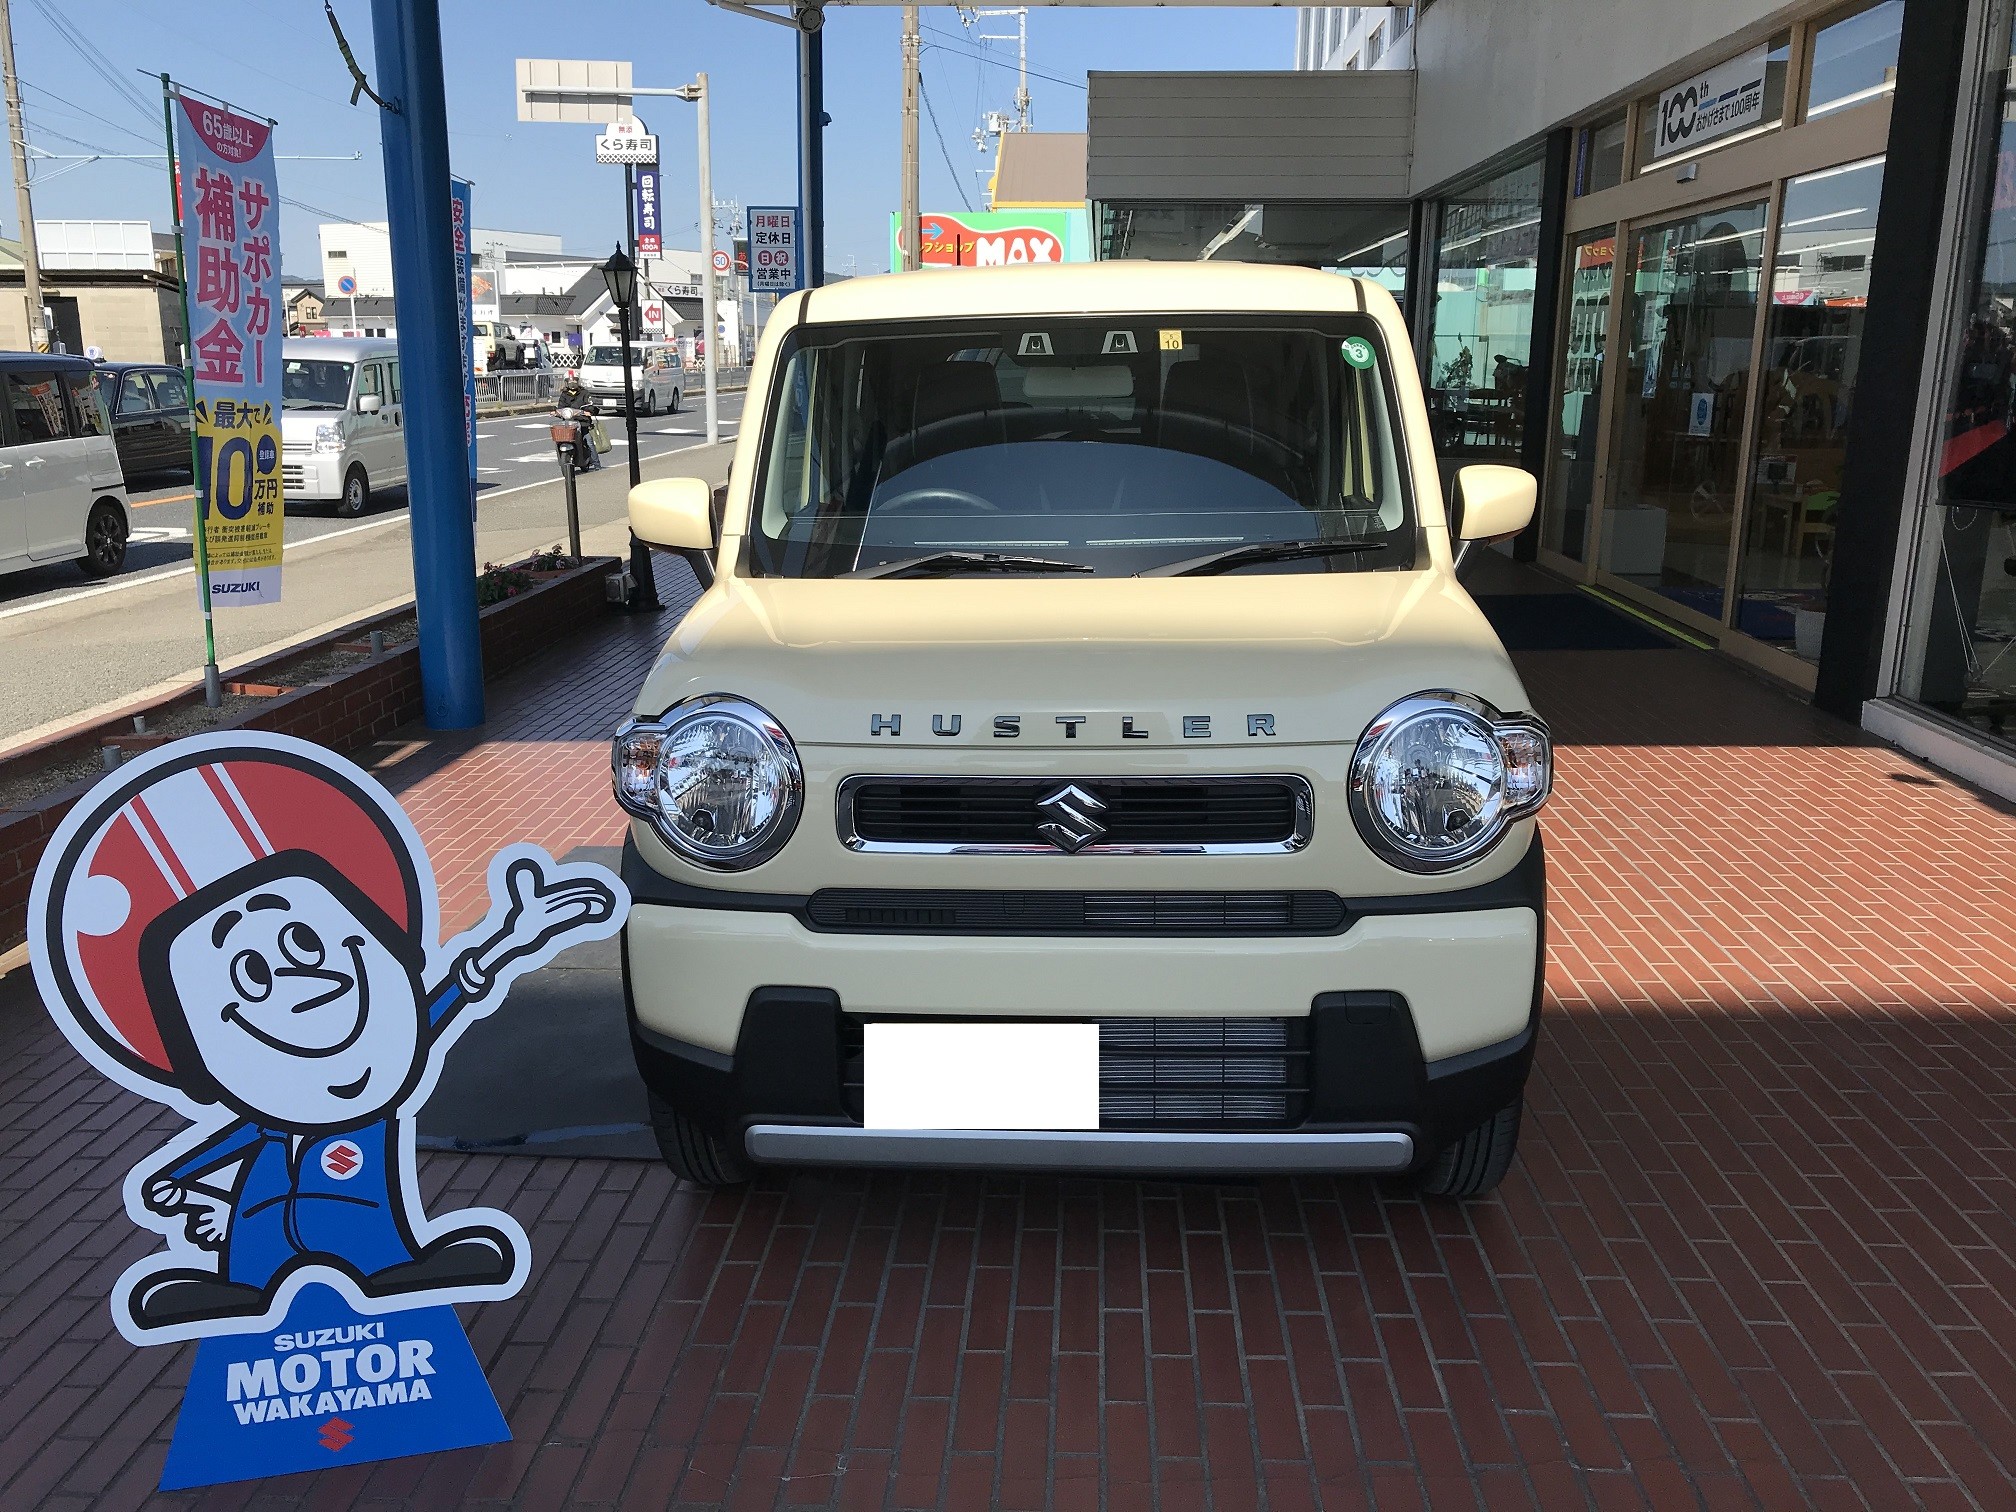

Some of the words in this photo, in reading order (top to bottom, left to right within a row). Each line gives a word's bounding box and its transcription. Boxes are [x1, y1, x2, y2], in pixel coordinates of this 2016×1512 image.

[1696, 90, 1761, 132] おかげさまで100周年
[203, 110, 253, 147] 65歳以上
[600, 139, 652, 151] くら寿司
[641, 175, 655, 230] 回転寿司
[755, 215, 790, 228] 月曜日
[755, 232, 791, 245] 定休日
[715, 257, 725, 265] 50
[976, 237, 1054, 266] MAX
[195, 167, 244, 383] 補助金
[239, 181, 272, 383] サポカー
[757, 268, 791, 280] 営業中
[667, 285, 698, 296] くら寿司
[648, 310, 659, 319] IN
[1165, 340, 1179, 350] 10
[1355, 348, 1363, 358] 3
[214, 402, 261, 429] 最大で
[197, 436, 253, 520] 10
[254, 479, 278, 499] 万円
[258, 502, 274, 516] 補助
[211, 581, 260, 594] SUZUKI
[871, 713, 1276, 739] HUSTLER
[274, 1321, 385, 1352] SUZUKI
[226, 1339, 437, 1402] MOTOR
[233, 1378, 432, 1425] WAKAYAMA
